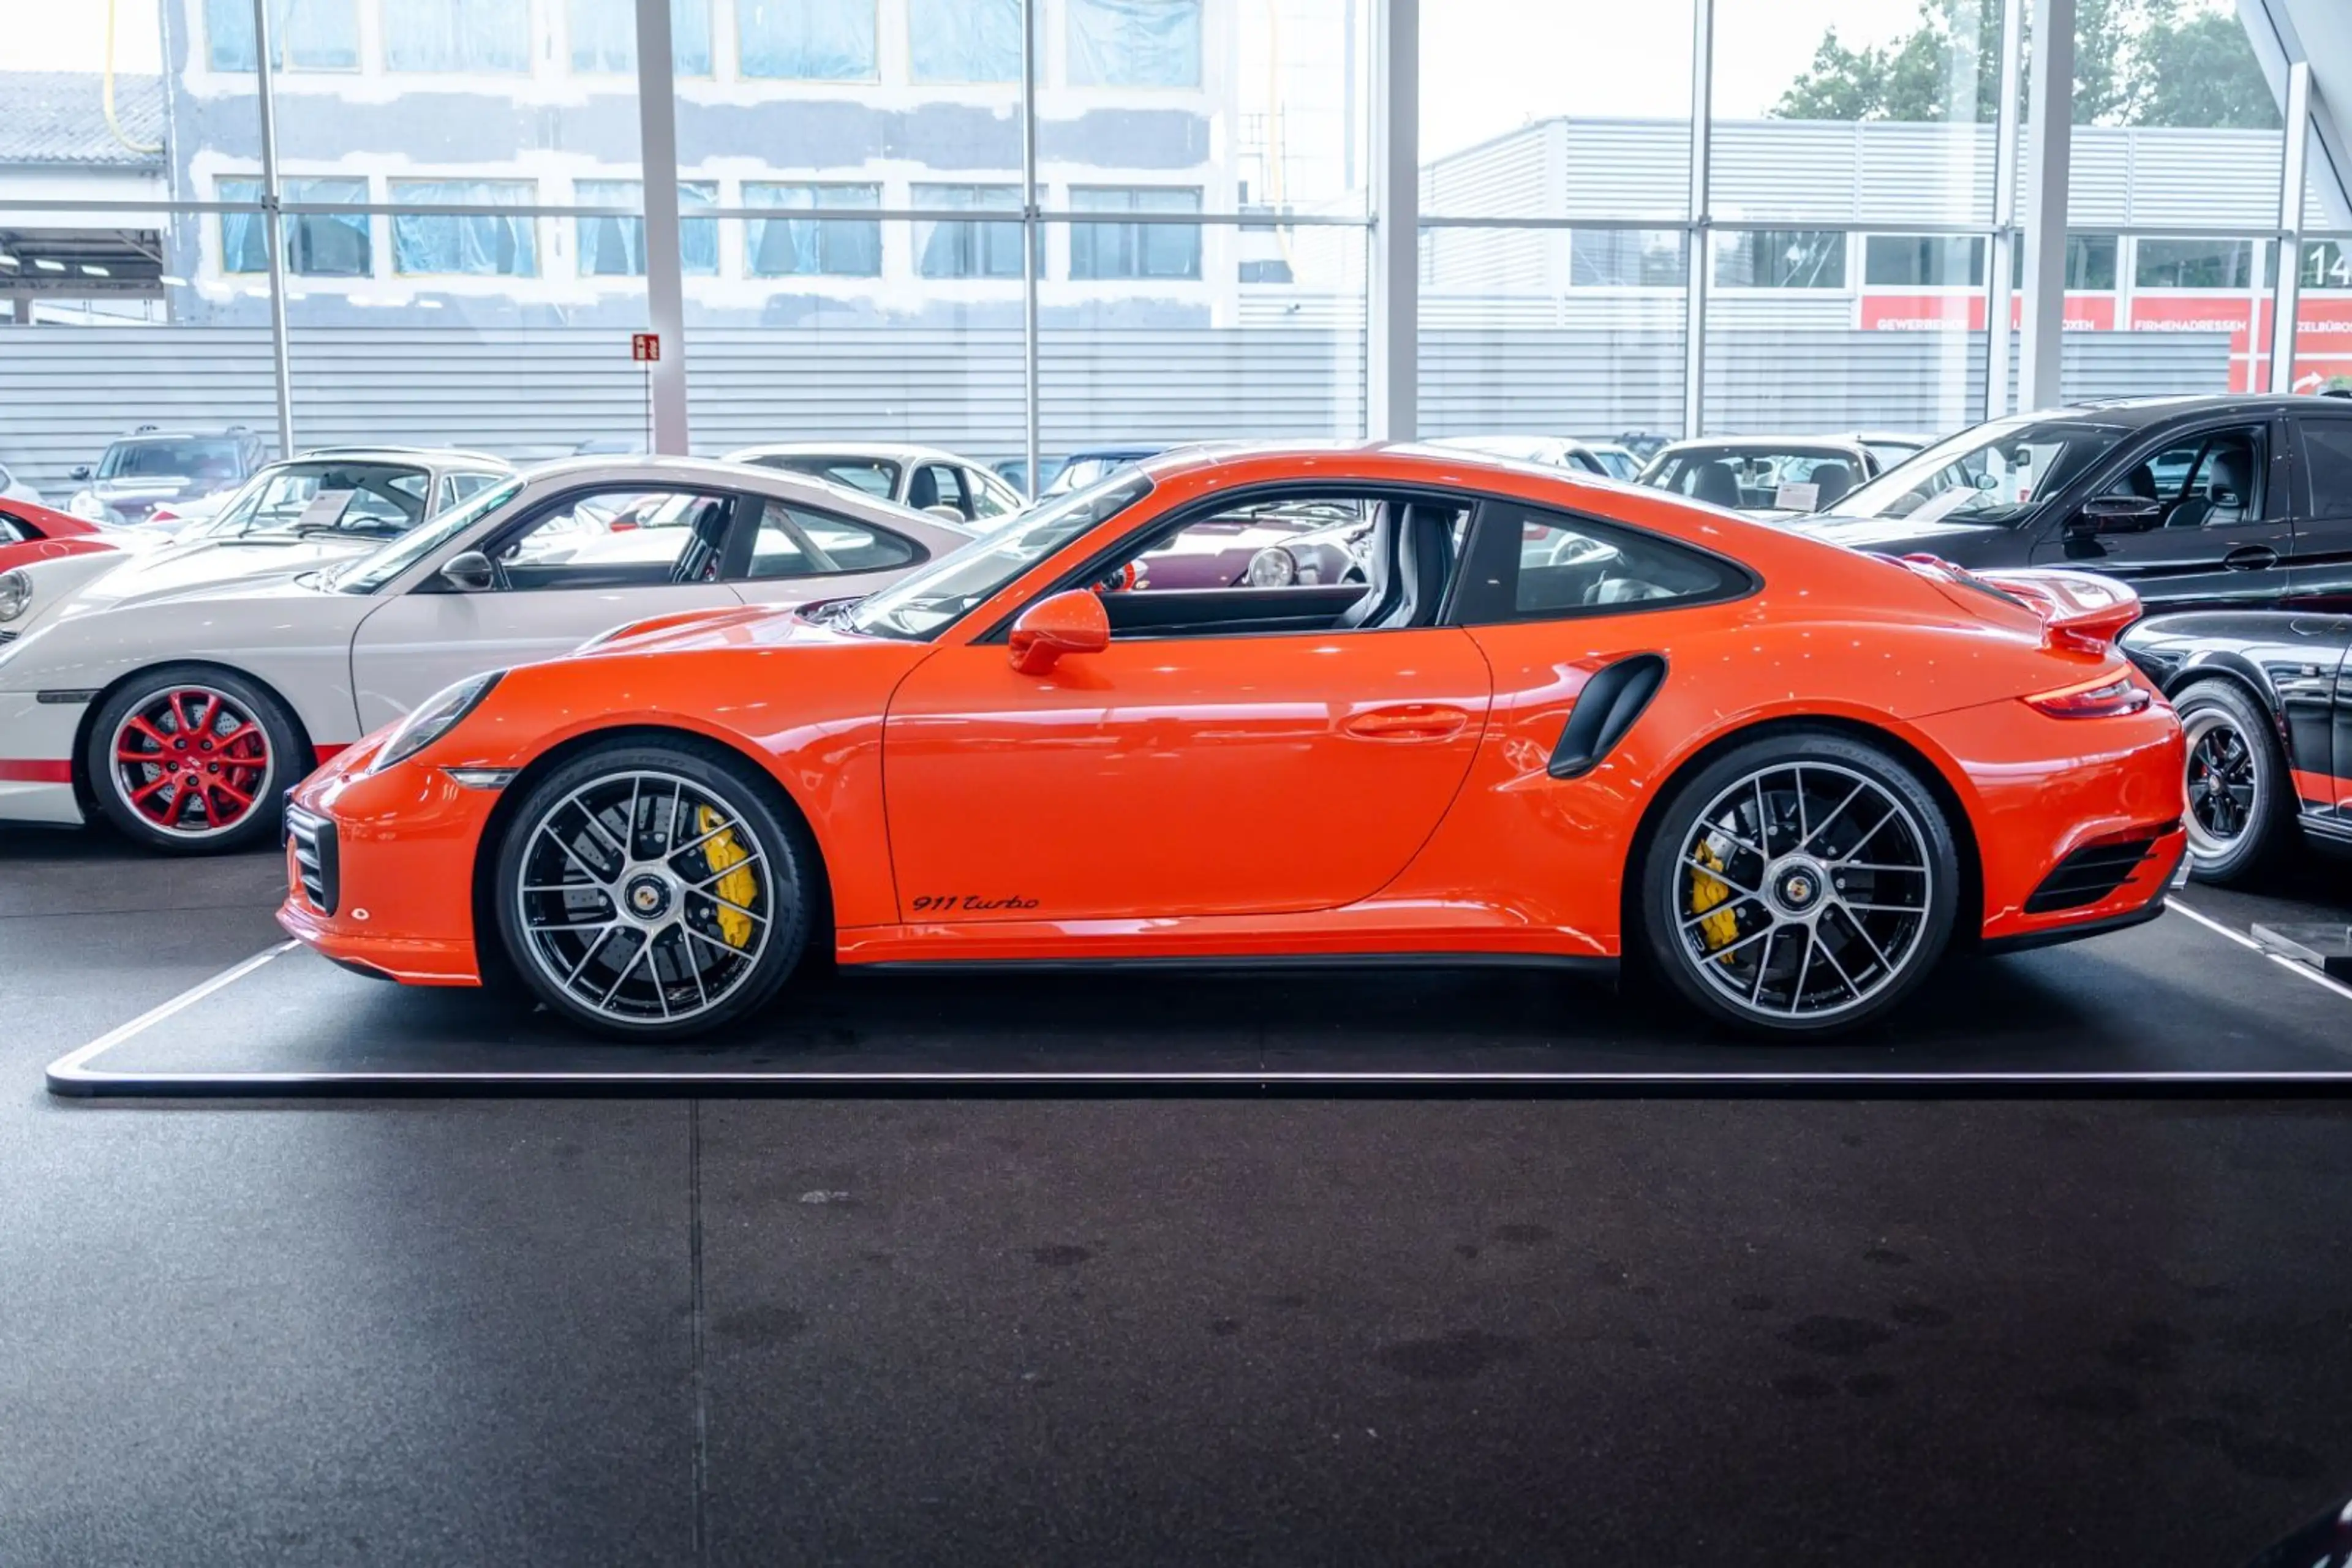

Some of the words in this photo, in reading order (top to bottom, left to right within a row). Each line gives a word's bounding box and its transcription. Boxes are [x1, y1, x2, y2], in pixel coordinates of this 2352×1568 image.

[2135, 320, 2247, 332] FIRMENADRESSEN
[913, 896, 957, 911] 911
[963, 895, 1039, 910] turbo
